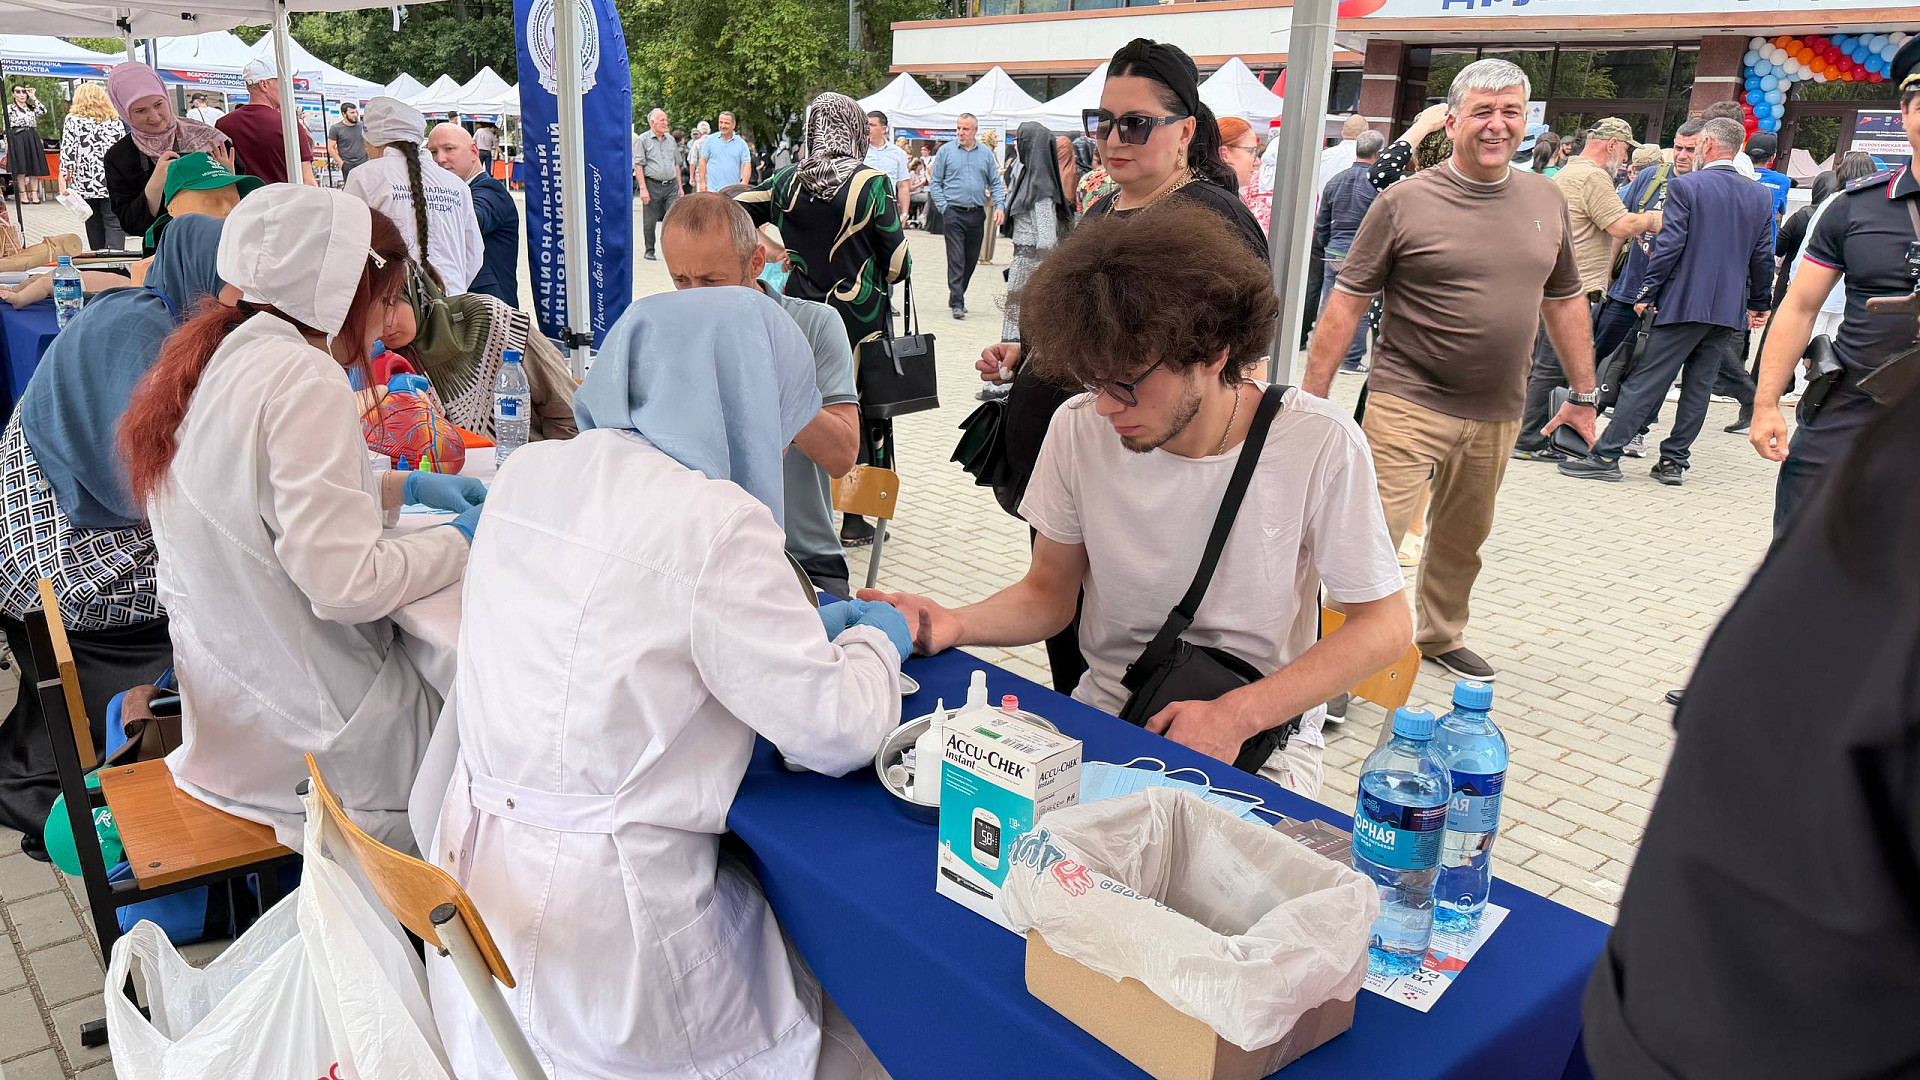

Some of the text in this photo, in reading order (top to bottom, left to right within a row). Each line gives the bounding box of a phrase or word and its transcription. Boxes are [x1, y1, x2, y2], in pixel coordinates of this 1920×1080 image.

[392, 185, 459, 199] НАЦНАЛЬНЫЙ
[392, 193, 461, 207] ИННЦИОННЫЙ
[535, 144, 552, 324] НАЦИОНАЛЬНЫЙ
[547, 122, 567, 327] ИННОВАЦИОННЫЙ
[588, 163, 606, 331] Начни свой путь к успеху!
[945, 748, 976, 769] Instant
[946, 734, 1026, 779] ACCU-CHEK
[1039, 758, 1077, 783] ACCU-CHEK
[1355, 811, 1396, 846] ОРНАЯ
